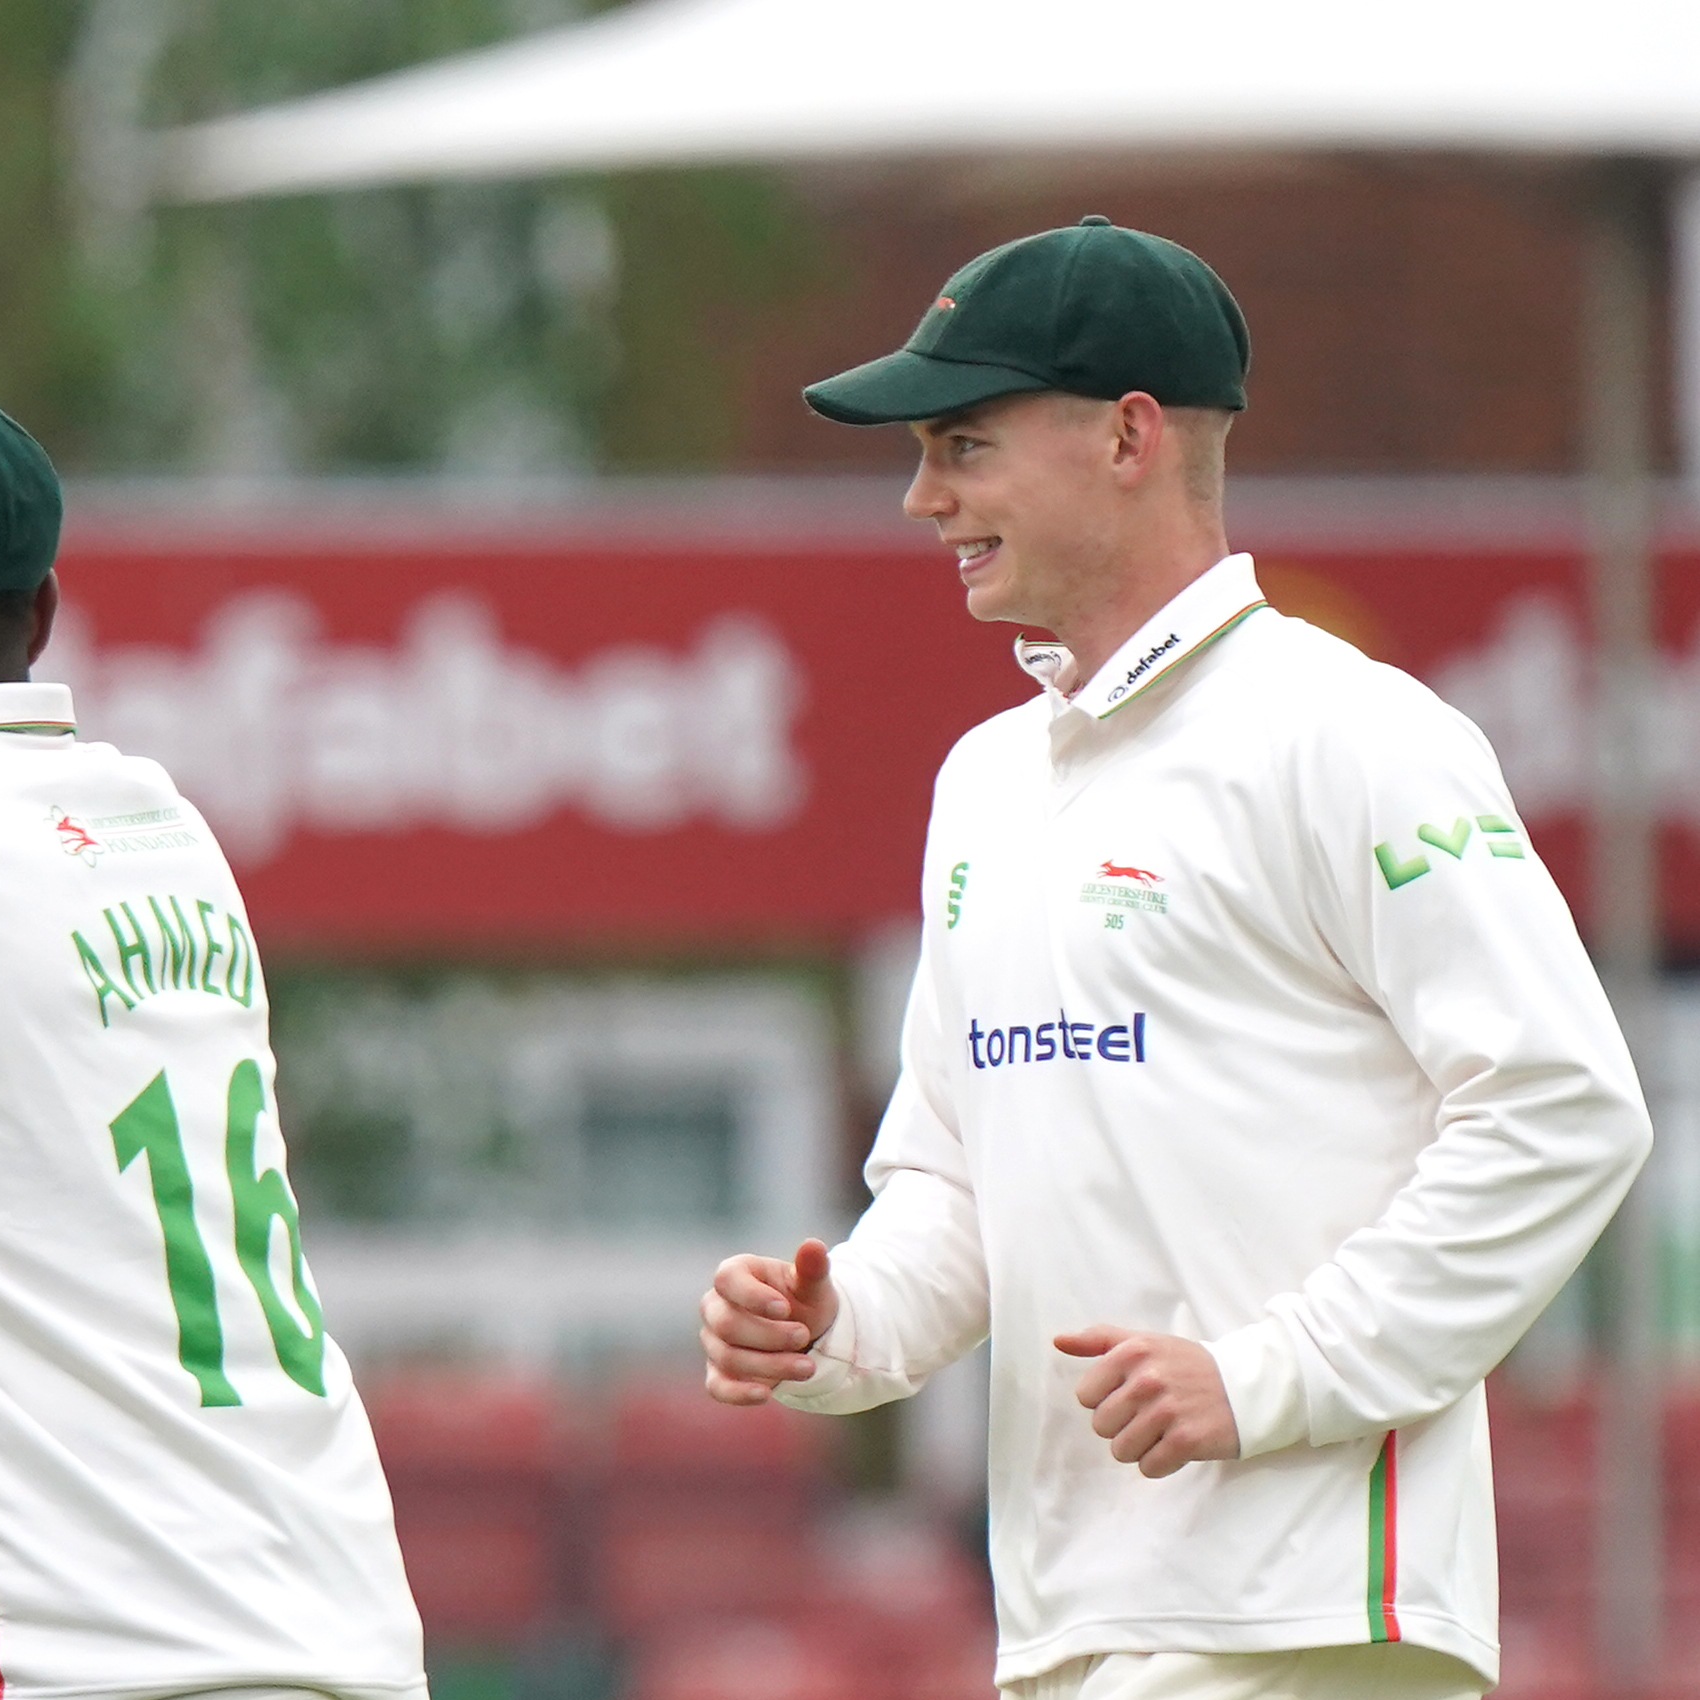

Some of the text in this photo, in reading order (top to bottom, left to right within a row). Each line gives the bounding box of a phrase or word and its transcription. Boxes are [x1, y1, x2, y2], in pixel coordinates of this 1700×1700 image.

[1126, 633, 1182, 685] dafabet
[55, 585, 808, 870] afabet
[102, 830, 200, 853] FOUNDATION
[1081, 883, 1168, 905] LEICESTERSHIRE
[1104, 912, 1125, 930] 505
[71, 895, 254, 1028] AHMED
[108, 1058, 327, 1407] 16
